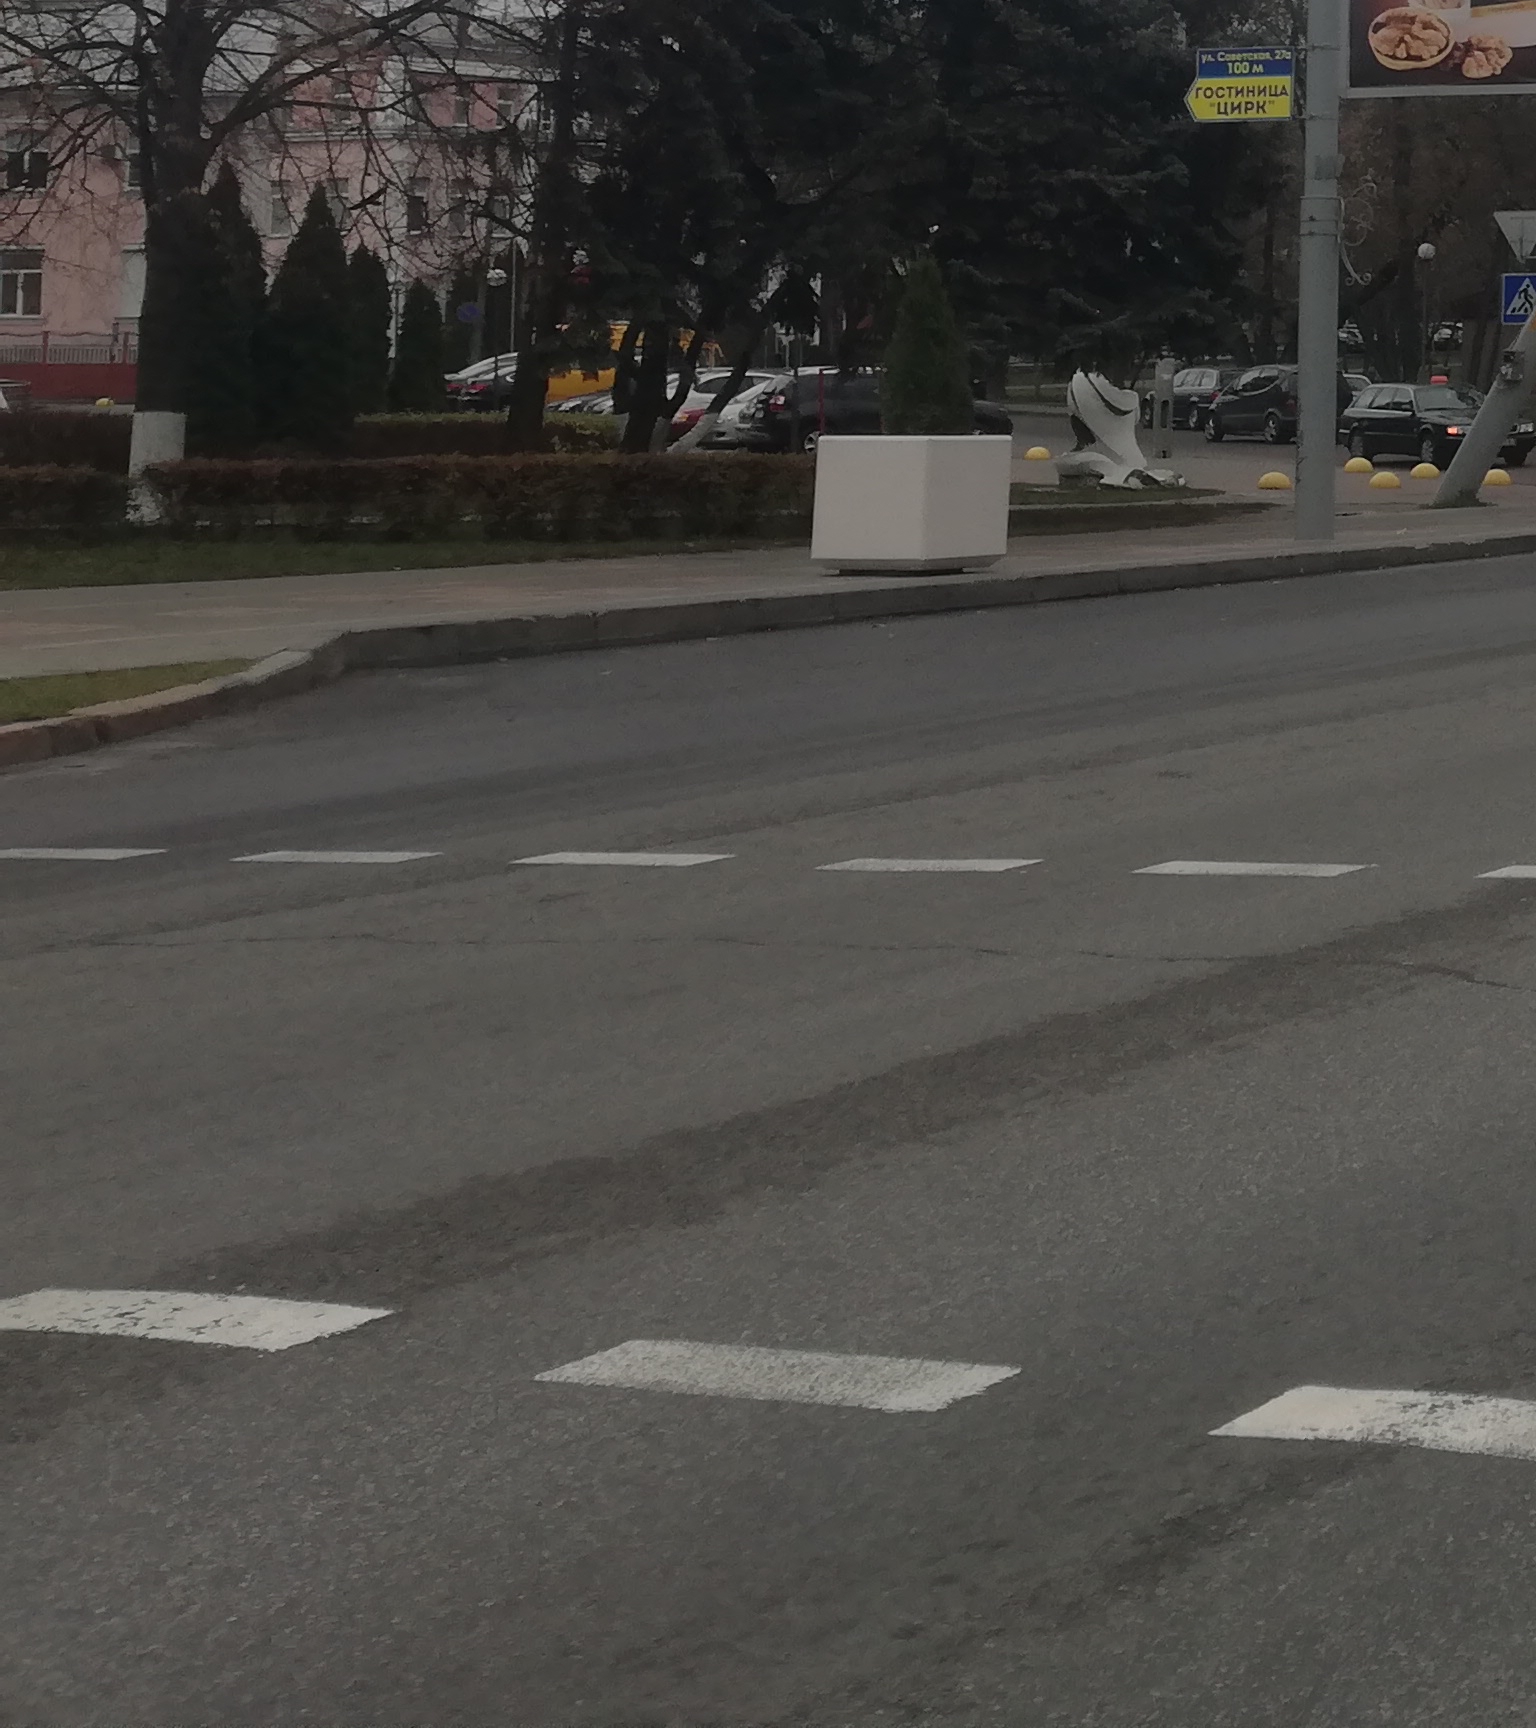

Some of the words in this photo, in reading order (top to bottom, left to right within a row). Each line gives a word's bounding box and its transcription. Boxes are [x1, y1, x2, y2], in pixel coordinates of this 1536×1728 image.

[1227, 62, 1250, 74] 100
[1252, 63, 1264, 74] м
[1195, 85, 1289, 99] ГОСТИНИЦА
[1210, 100, 1275, 116] "ЦИРК"
